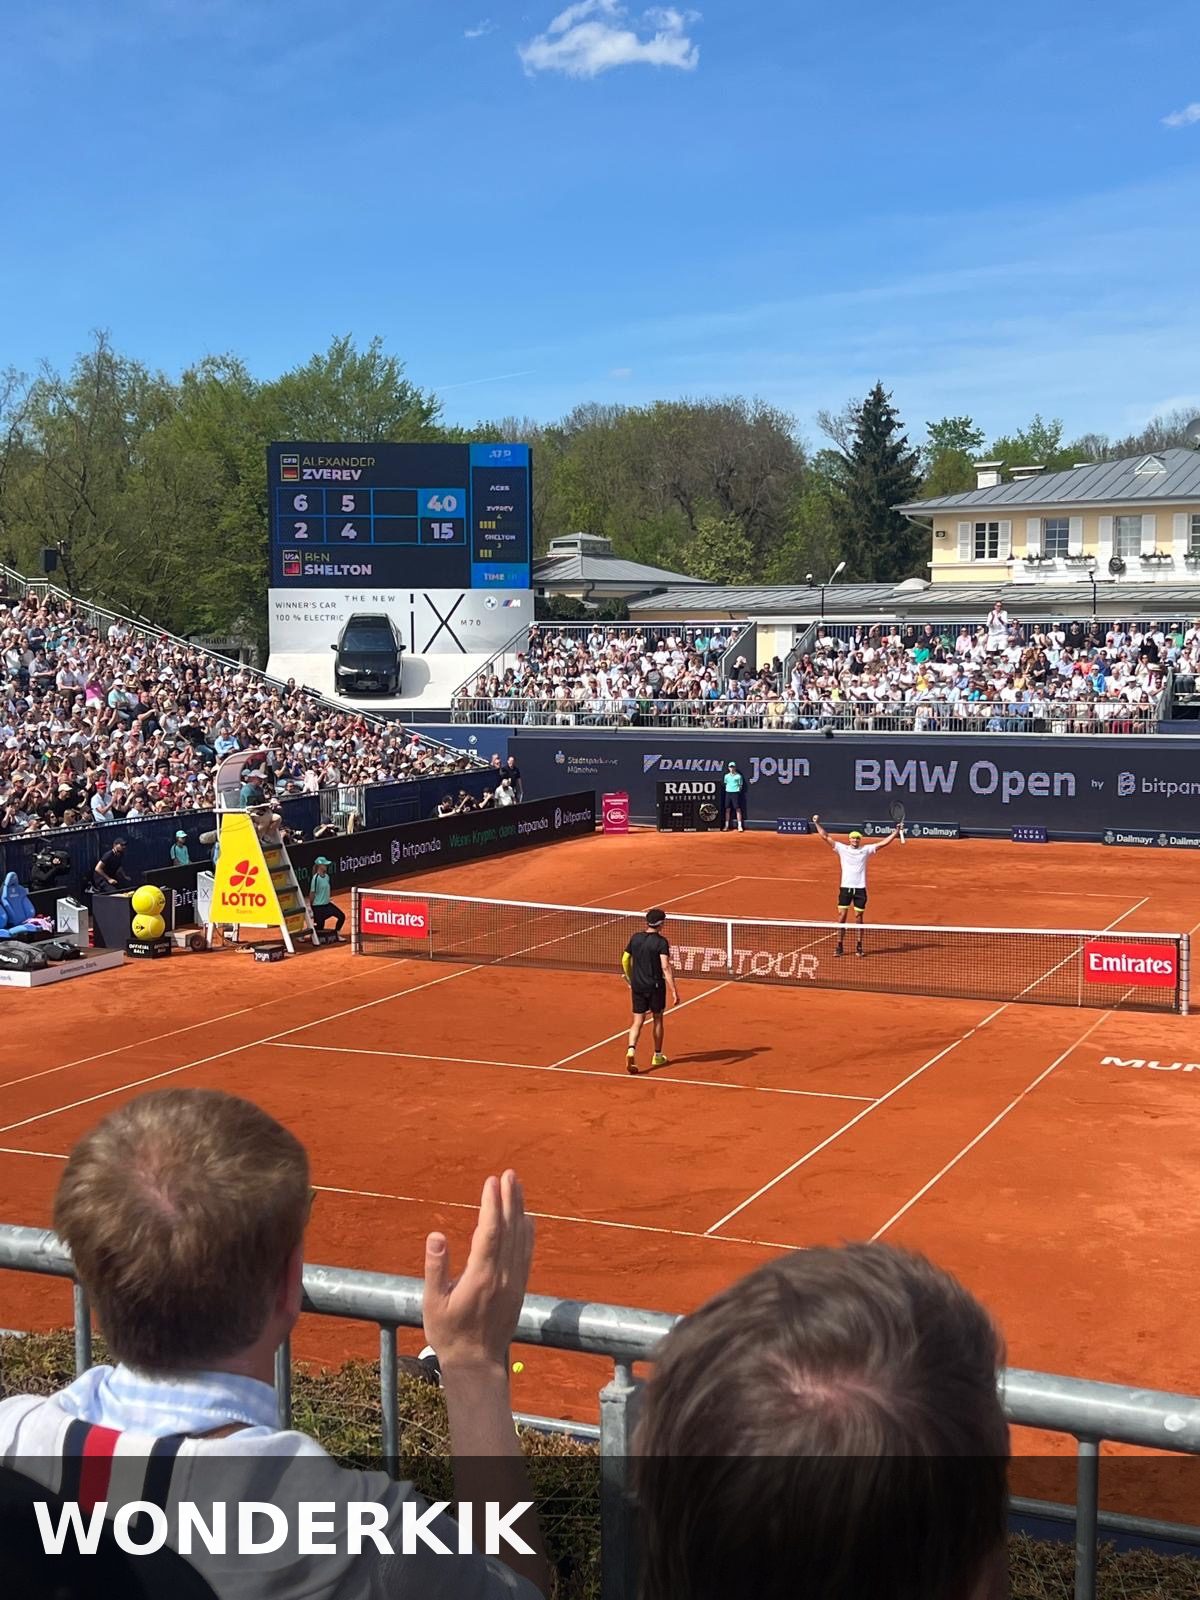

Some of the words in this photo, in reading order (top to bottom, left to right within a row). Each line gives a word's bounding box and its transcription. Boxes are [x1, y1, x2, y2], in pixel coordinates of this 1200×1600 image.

[302, 457, 376, 467] ALEXANDER
[302, 468, 362, 480] ZVEREV
[293, 494, 308, 512] 6
[341, 495, 355, 512] 5
[427, 495, 457, 512] 40
[294, 522, 308, 539] 2
[341, 523, 357, 539] 4
[430, 523, 454, 540] 15
[305, 552, 330, 562] BEN
[304, 564, 372, 575] SHELTON
[484, 573, 504, 581] TIME
[275, 614, 290, 622] 100
[304, 614, 344, 622] ELECTRIC
[410, 593, 467, 654] iX
[659, 758, 725, 772] DAIKIN
[664, 782, 716, 794] RADO
[855, 759, 959, 793] BMW
[969, 760, 1076, 803] Open
[1091, 779, 1104, 790] by
[563, 808, 592, 825] bitpanda
[517, 816, 549, 836] bitpanda
[922, 826, 958, 836] Dallmayr
[1116, 834, 1153, 844] Dallmayr
[402, 837, 441, 860] bitpanda
[340, 850, 382, 873] bitpanda
[221, 892, 266, 907] LOTTO
[364, 908, 425, 927] Emirates
[734, 949, 820, 980] TOUR
[1089, 953, 1173, 974] Emirates
